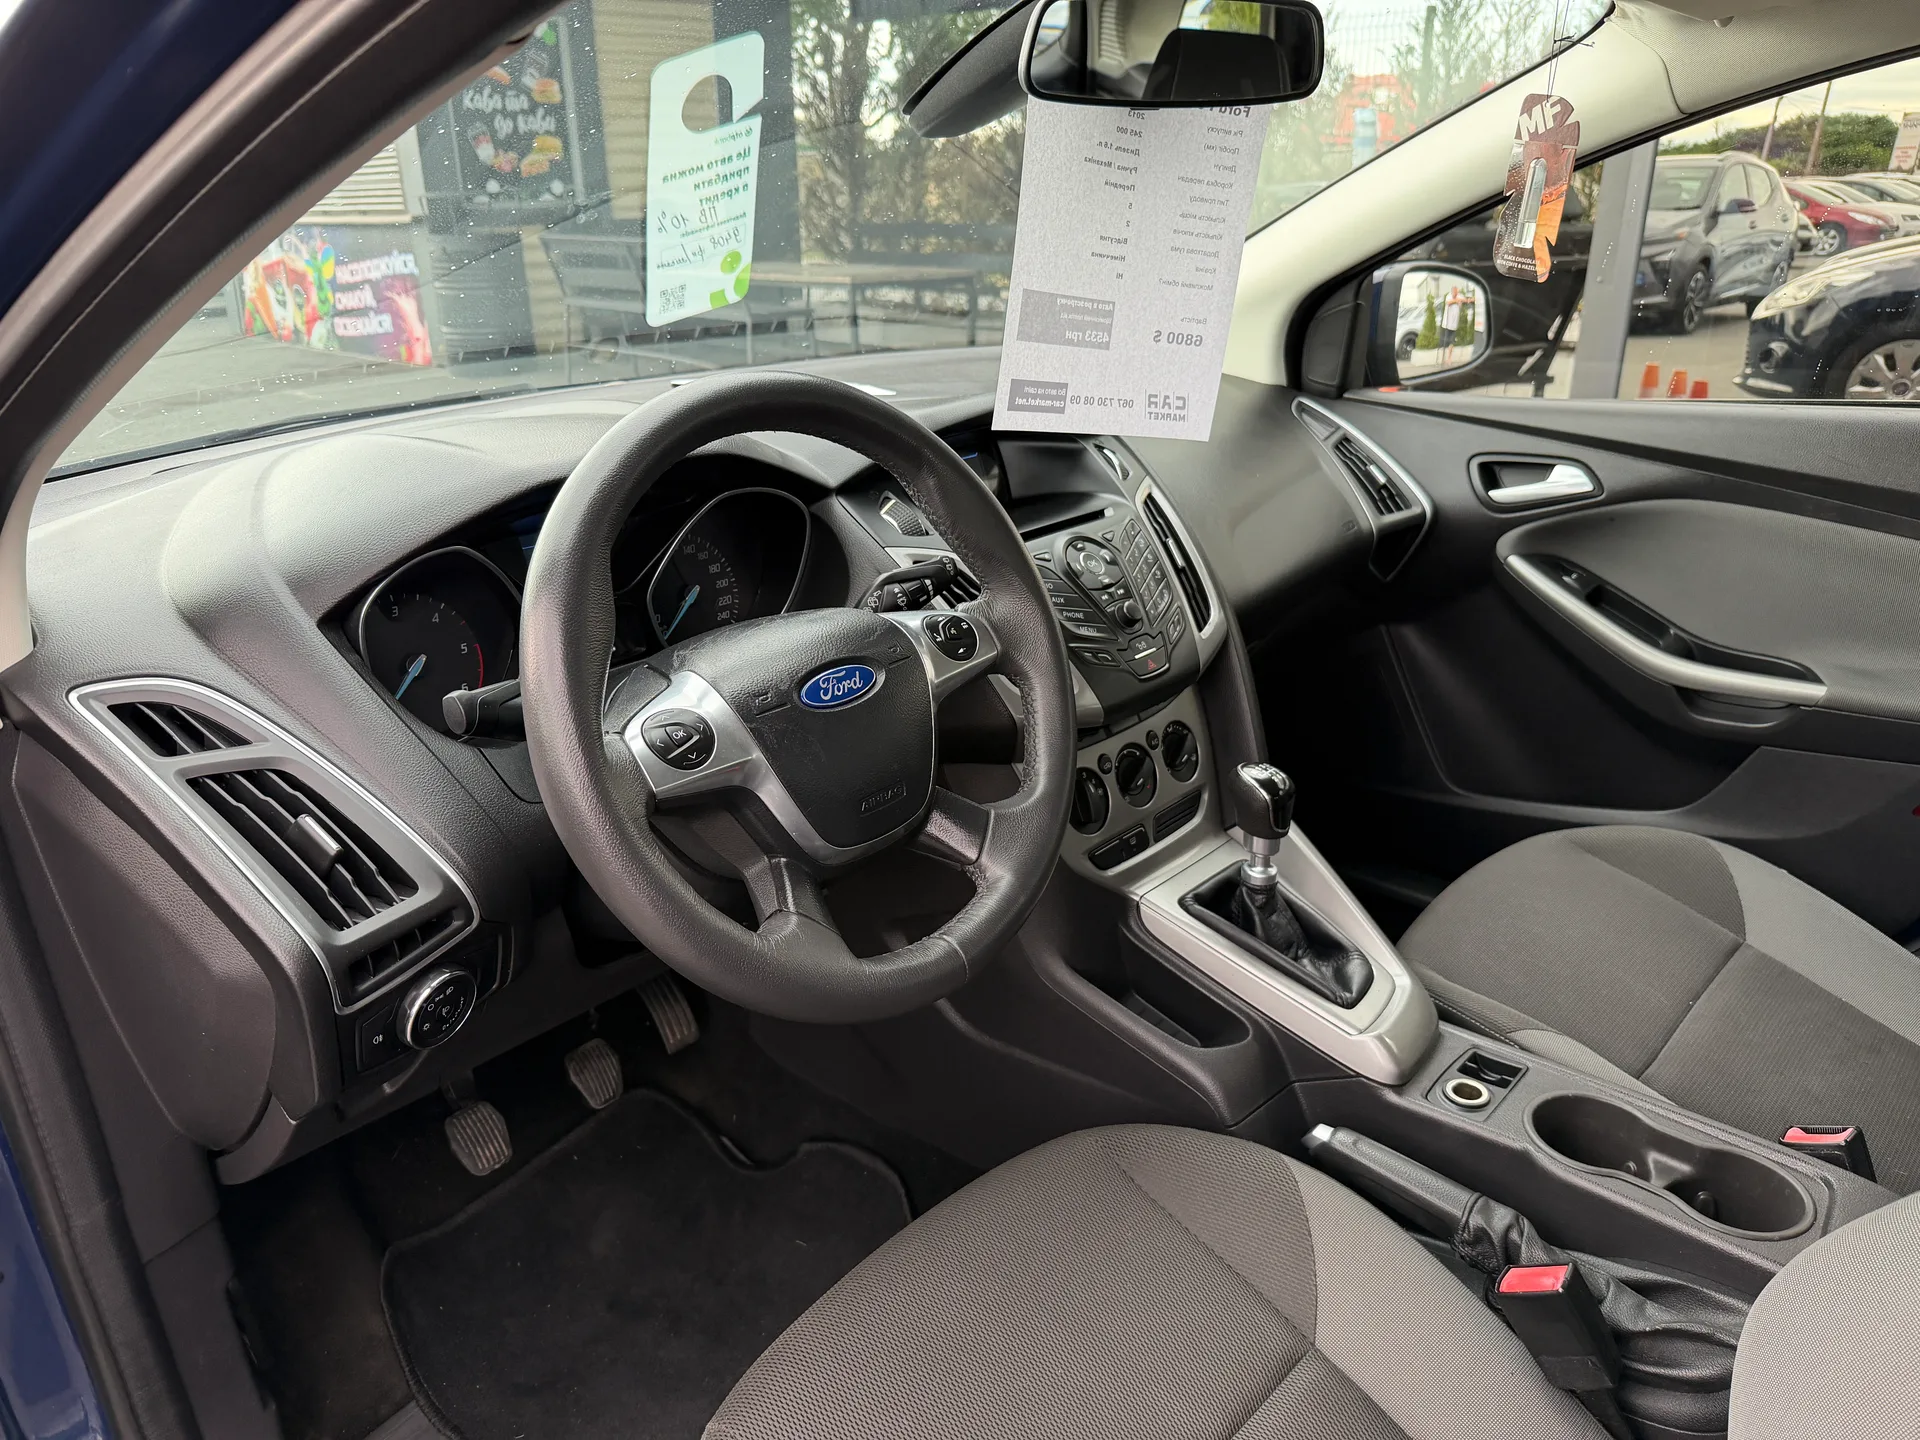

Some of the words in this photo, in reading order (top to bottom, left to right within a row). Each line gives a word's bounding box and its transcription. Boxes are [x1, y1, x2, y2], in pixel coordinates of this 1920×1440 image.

[1518, 96, 1562, 141] MF
[684, 544, 695, 555] 140
[709, 563, 720, 574] 180
[716, 579, 729, 589] 200
[719, 595, 732, 606] 220
[1051, 596, 1065, 604] AUX
[392, 606, 399, 617] 3
[717, 611, 730, 621] 240
[1063, 611, 1084, 619] PHONE
[432, 613, 440, 623] 4
[1080, 626, 1097, 634] MENU
[461, 643, 468, 654] 5
[820, 670, 863, 701] Ford
[673, 730, 687, 739] OK
